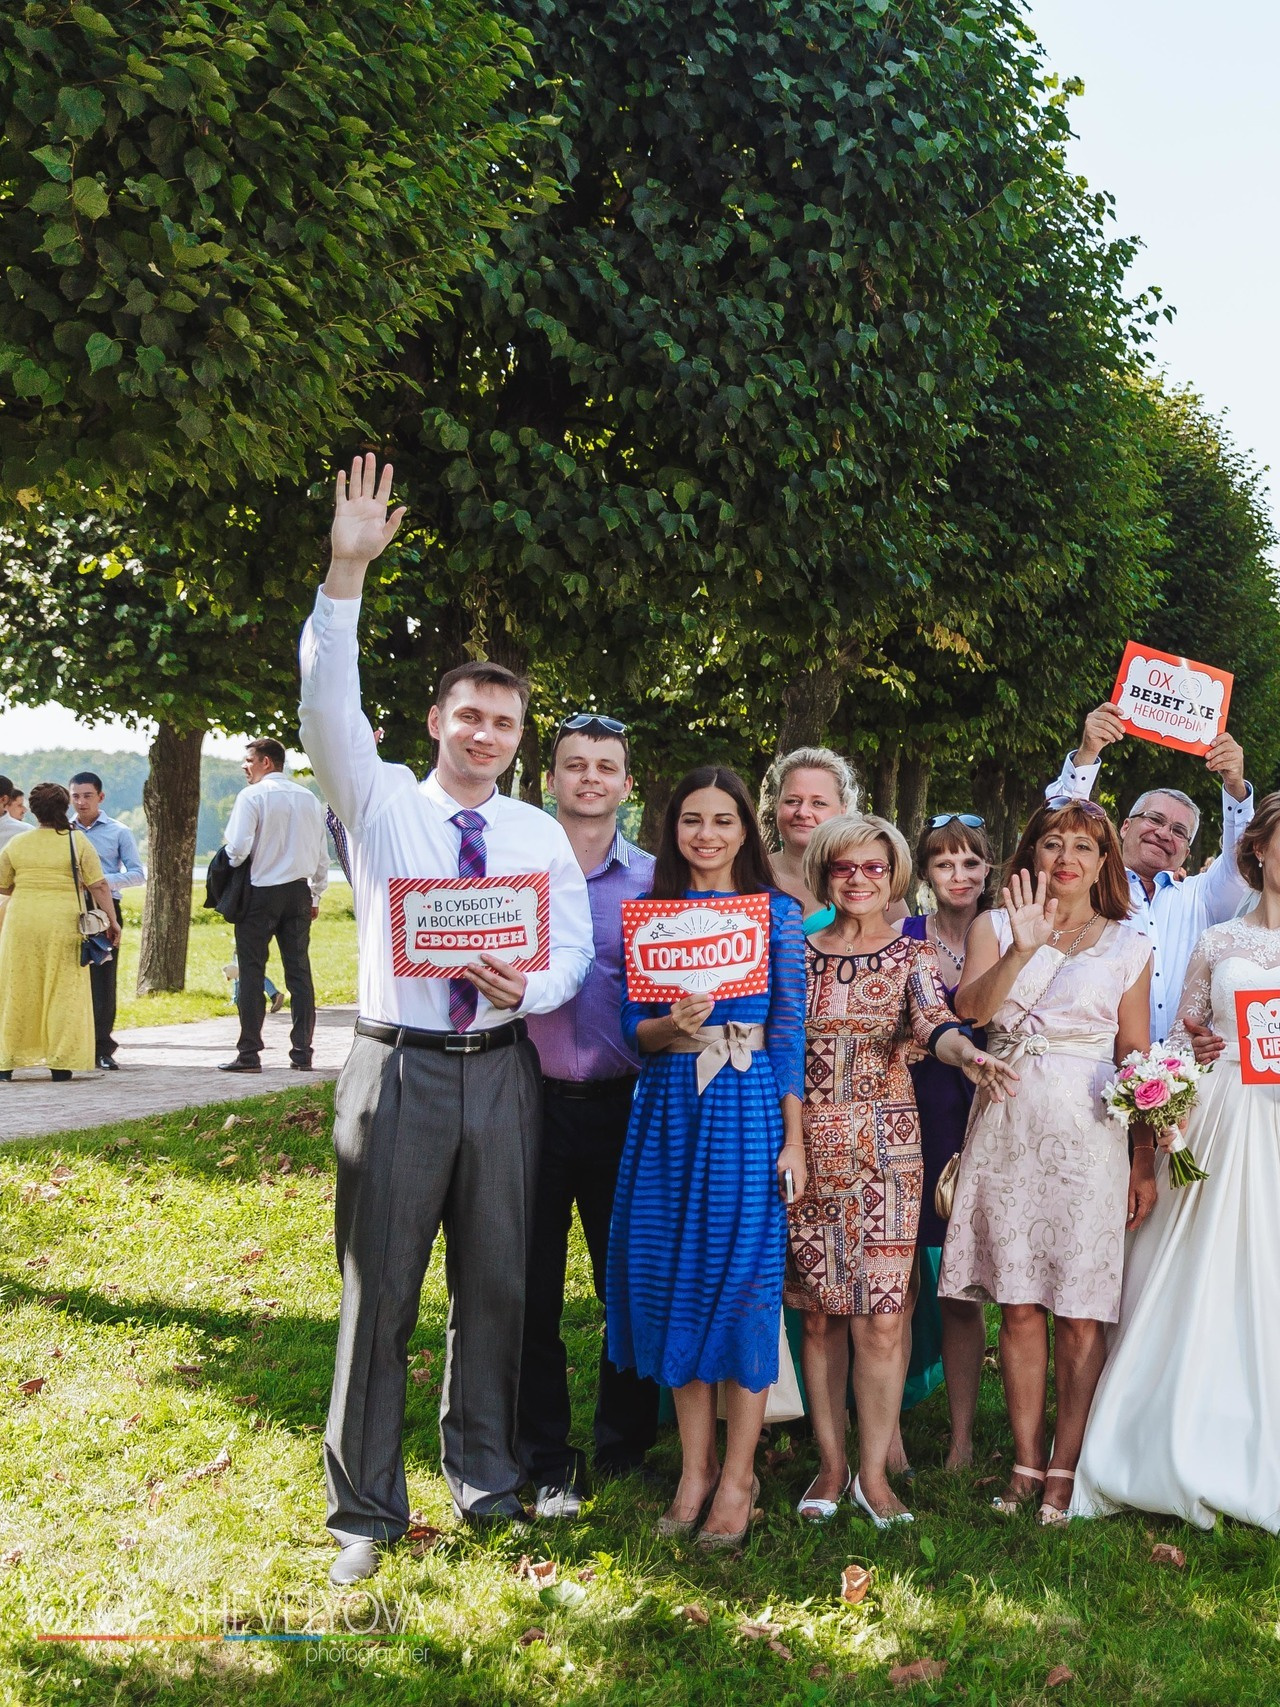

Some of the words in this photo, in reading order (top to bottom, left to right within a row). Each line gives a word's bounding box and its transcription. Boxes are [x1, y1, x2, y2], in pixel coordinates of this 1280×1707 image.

[1148, 669, 1175, 694] ОХ,
[1129, 685, 1184, 711] ВЕЗЕТ
[434, 900, 443, 912] В
[446, 897, 504, 912] СУББОТУ
[418, 916, 427, 928] И
[431, 909, 522, 928] ВОСКРЕСЕНЬЕ
[417, 931, 525, 949] СВОБОДЕН
[648, 932, 752, 969] ГОРЬКООО!
